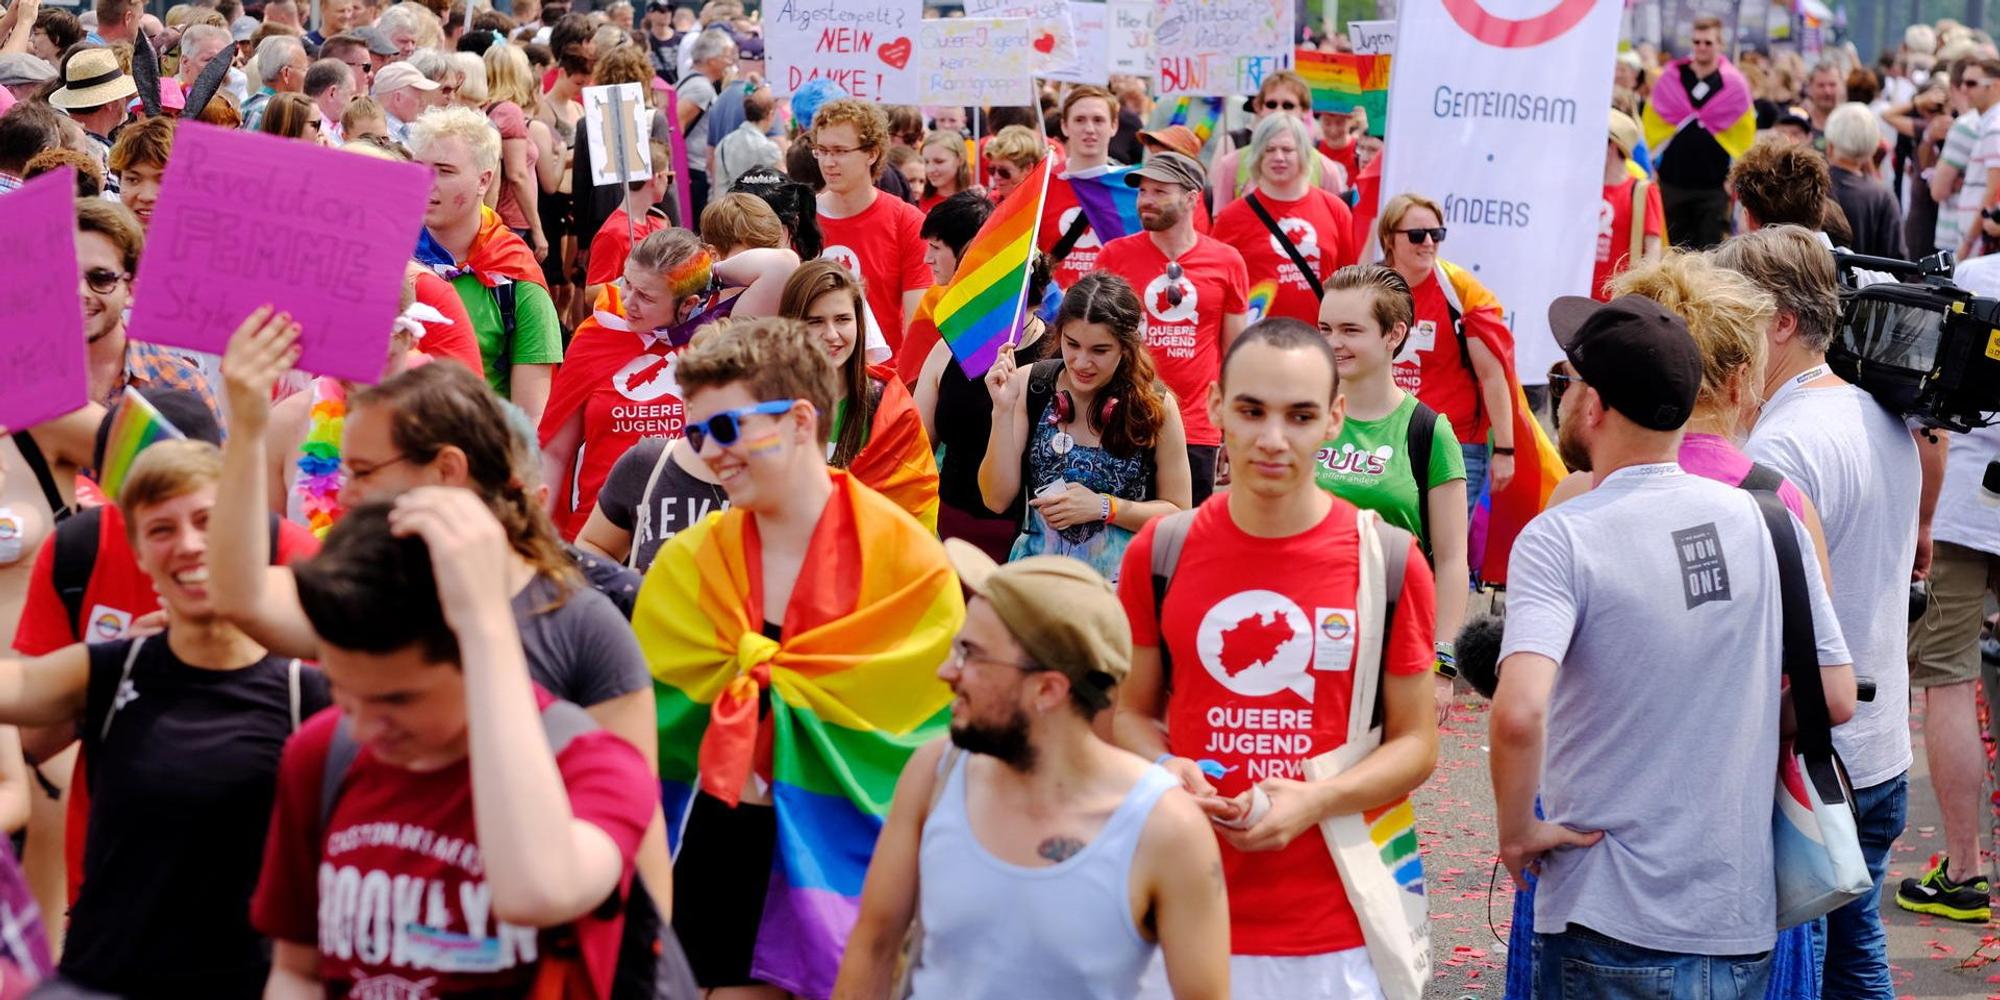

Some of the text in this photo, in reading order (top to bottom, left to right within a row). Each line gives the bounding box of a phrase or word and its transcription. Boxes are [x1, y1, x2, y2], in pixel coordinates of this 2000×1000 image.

[815, 27, 873, 53] NEIN
[1160, 52, 1217, 93] BUNT
[168, 203, 372, 304] FEMME
[1148, 325, 1198, 336] QUEERE
[1145, 336, 1197, 348] JUGEND
[1166, 347, 1196, 360] NRW
[611, 403, 683, 419] QUEERE
[611, 418, 682, 434] JUGEND
[1688, 567, 1724, 596] ONE
[1206, 705, 1314, 730] QUEERE
[1204, 732, 1313, 755] JUGEND
[1247, 758, 1306, 780] NRW
